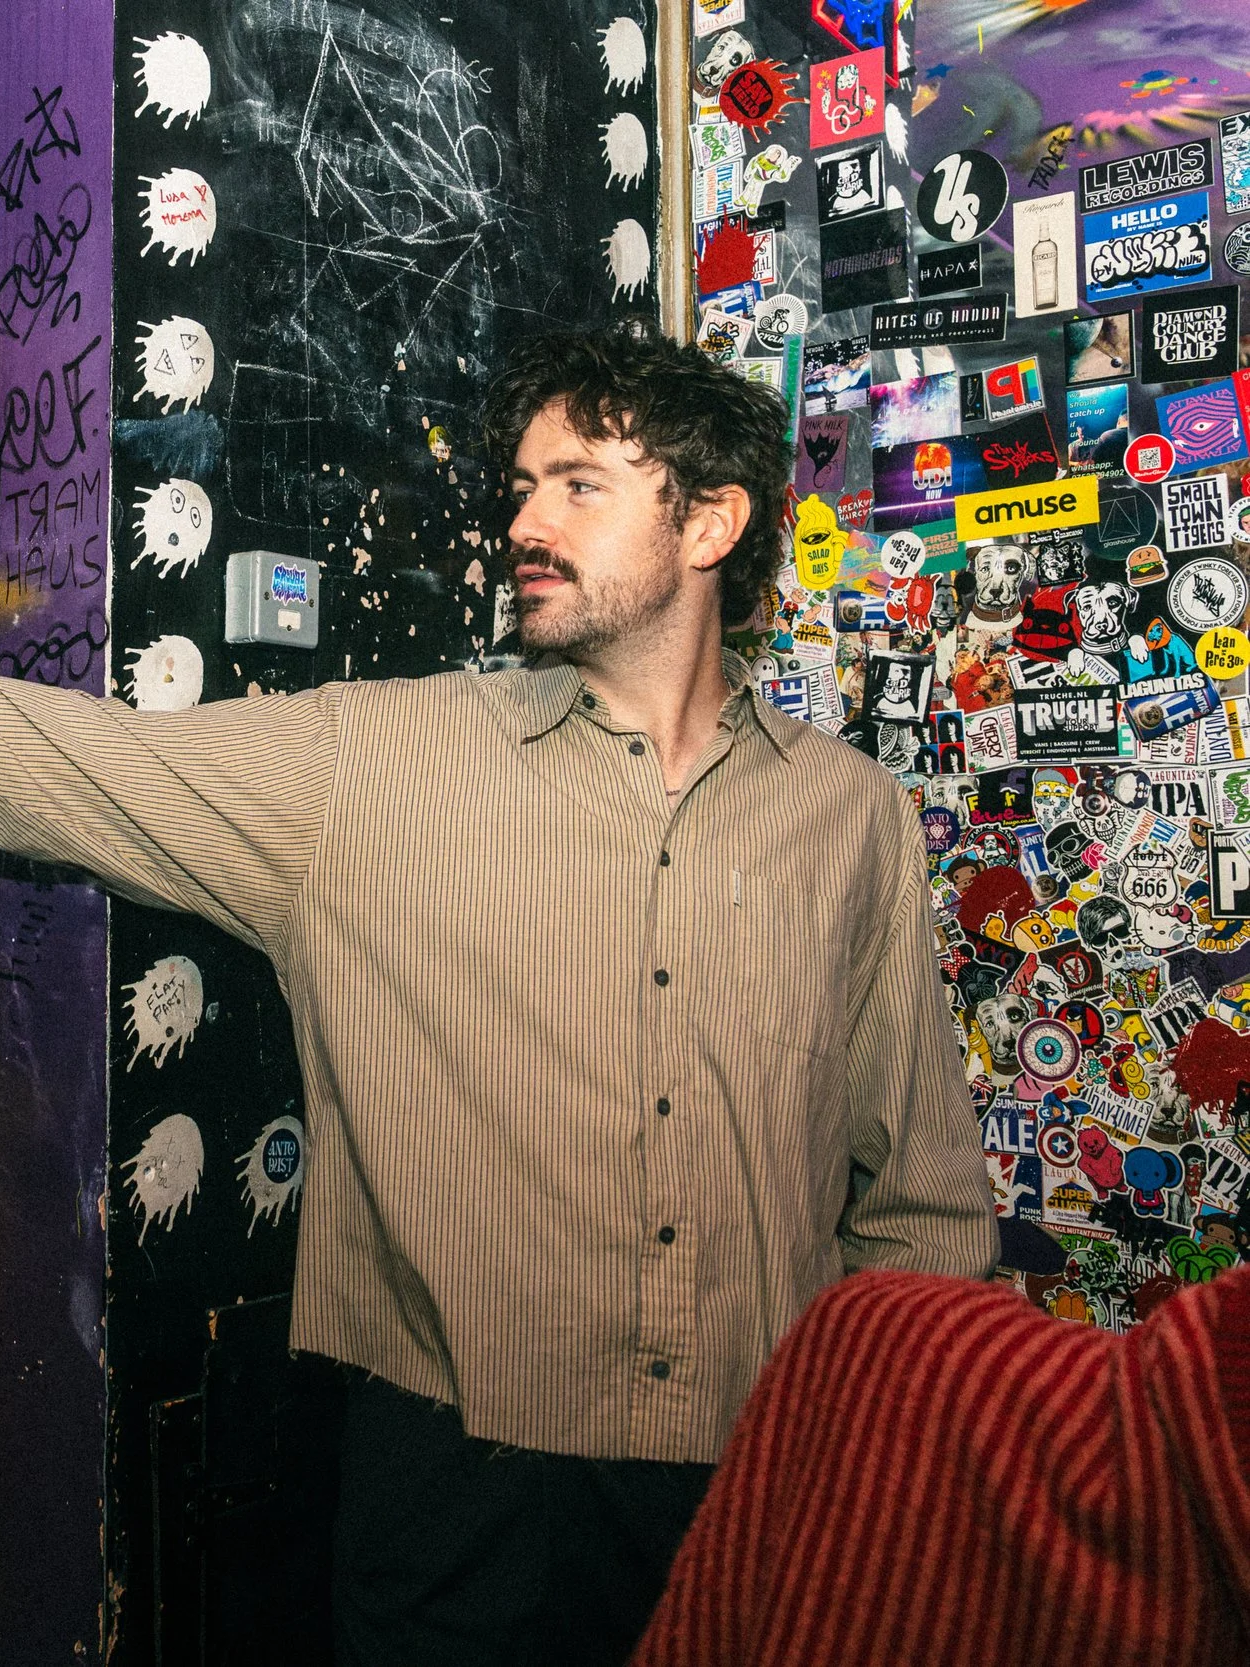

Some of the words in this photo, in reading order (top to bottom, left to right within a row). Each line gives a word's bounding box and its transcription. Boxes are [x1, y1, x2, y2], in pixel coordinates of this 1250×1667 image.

[730, 83, 760, 118] HELLO
[1083, 143, 1206, 197] LEWIS
[1085, 170, 1206, 209] RECORDINGS
[1111, 203, 1178, 230] HELLO
[875, 314, 918, 330] RITES
[925, 311, 944, 326] OF
[1152, 316, 1227, 338] COUNTRY
[1154, 328, 1227, 350] DANCE
[1160, 341, 1218, 363] CLUB
[1069, 399, 1098, 409] should
[1069, 408, 1093, 418] catch
[1094, 407, 1106, 416] up
[804, 420, 824, 431] PINK
[824, 419, 844, 431] MILK
[912, 467, 953, 490] UDI
[925, 488, 943, 500] NOW
[974, 493, 1077, 525] amuse
[1168, 499, 1224, 527] TOWN
[807, 548, 830, 561] SALAD
[812, 562, 829, 575] DAYS
[1217, 564, 1240, 584] FOREVER
[797, 622, 831, 636] SUPER
[1213, 632, 1235, 649] Lean
[1205, 650, 1225, 668] Perc
[1039, 691, 1089, 700] TRUCHE.NL
[1119, 673, 1206, 700] LAGUNITAS
[1017, 689, 1115, 735] TRUCHÉ
[966, 731, 988, 757] JANE
[979, 716, 1004, 759] CHERRY
[1149, 769, 1197, 781] LAGUNITAS
[1150, 782, 1208, 817] IPA
[1132, 877, 1168, 899] 666
[146, 976, 179, 1009] FLAT
[153, 980, 188, 1026] PARTY
[1091, 1095, 1146, 1137] DAYTIME
[983, 1116, 1037, 1155] ALE
[1052, 1187, 1093, 1200] SUPER
[1019, 1206, 1042, 1215] PUNK
[1045, 1199, 1093, 1214] CLUSTE
[1019, 1214, 1043, 1222] ROCK
[1067, 1228, 1091, 1237] MUTANT
[1091, 1231, 1111, 1240] NINJA
